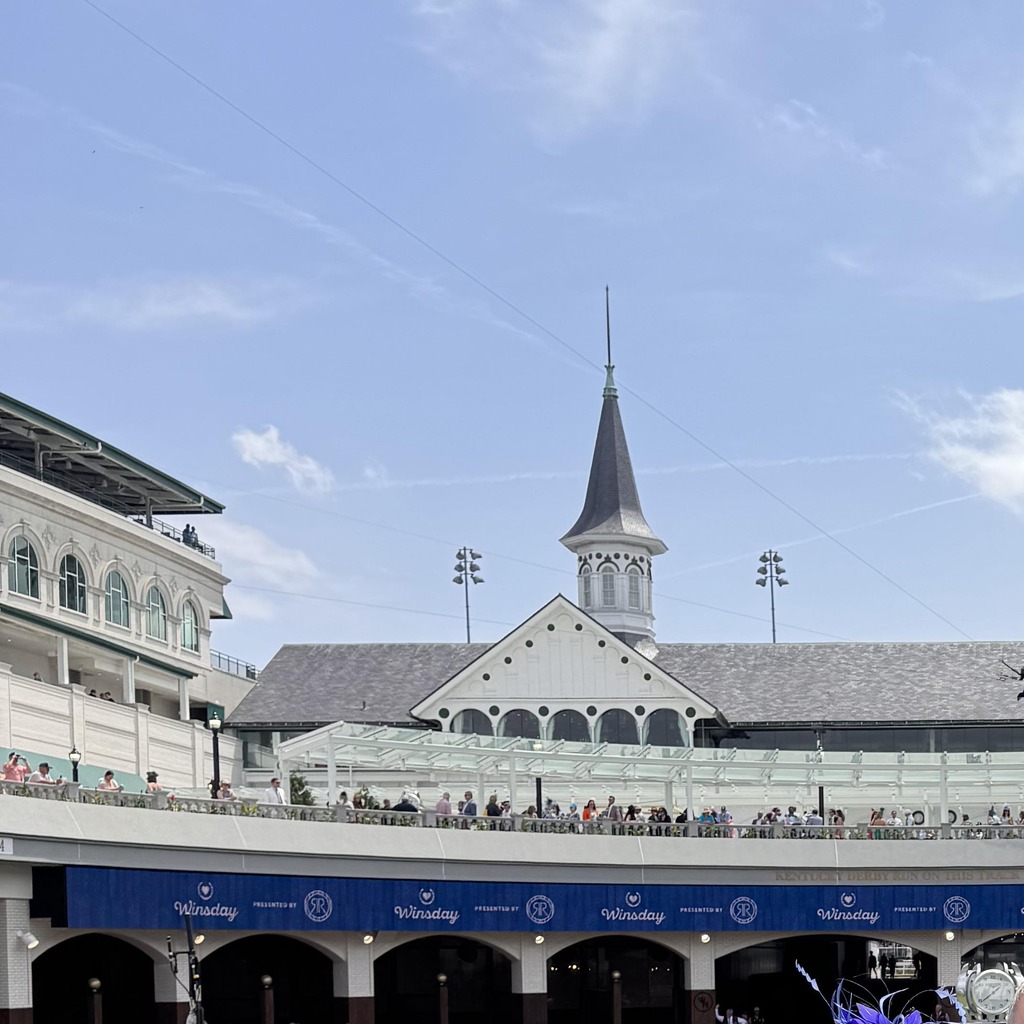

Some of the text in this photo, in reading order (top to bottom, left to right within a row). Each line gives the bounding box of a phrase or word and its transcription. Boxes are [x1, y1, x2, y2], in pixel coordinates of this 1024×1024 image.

[775, 871, 842, 881] KENTUCKY
[847, 871, 888, 881] DERBY
[892, 870, 918, 881] RUN
[922, 870, 940, 880] ON
[943, 870, 973, 880] THIS
[174, 900, 239, 922] Winsday
[394, 905, 460, 925] Winsday
[601, 907, 666, 925] Winsday
[816, 908, 881, 925] Winsday
